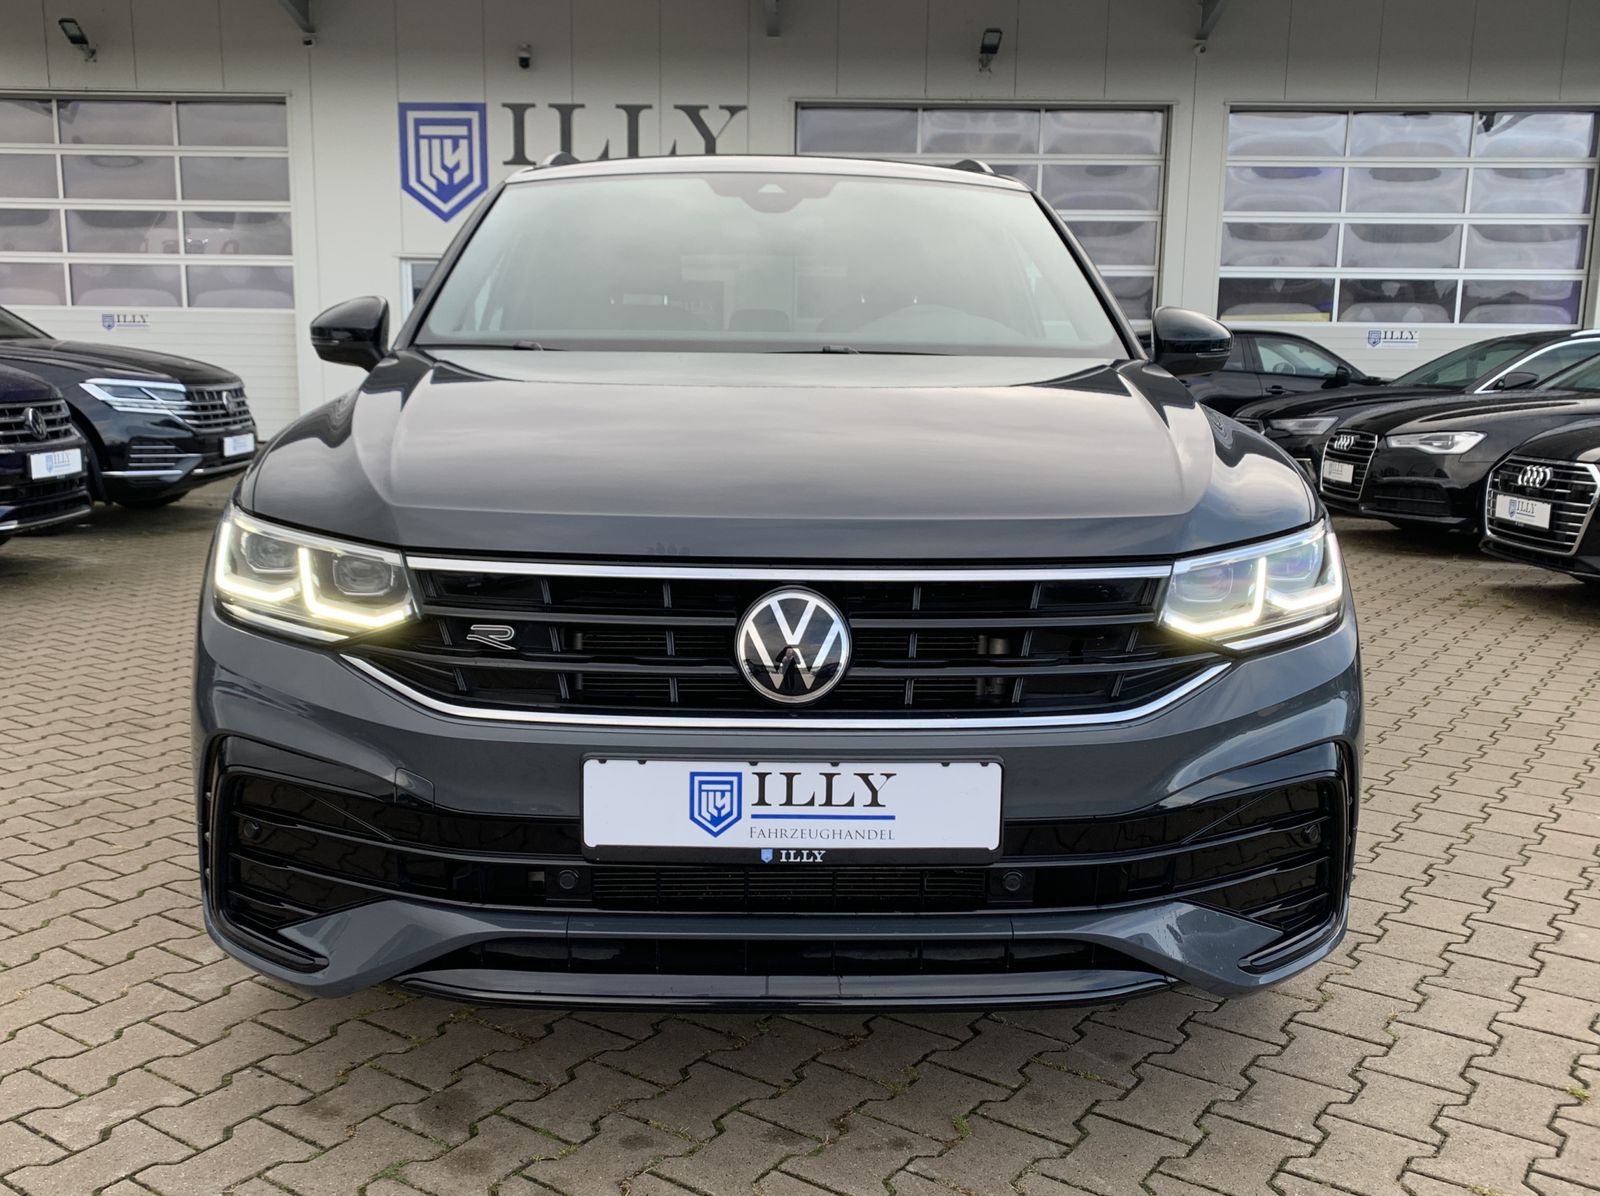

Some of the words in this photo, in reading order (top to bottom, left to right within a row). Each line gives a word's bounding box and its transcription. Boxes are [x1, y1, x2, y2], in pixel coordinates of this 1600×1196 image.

[501, 103, 747, 165] ILLY
[116, 313, 149, 323] ILLY
[1383, 330, 1418, 340] ILLY
[751, 772, 897, 808] ILLY
[749, 826, 896, 841] FAHRZEUGHANDEL
[779, 850, 826, 863] ILLY
